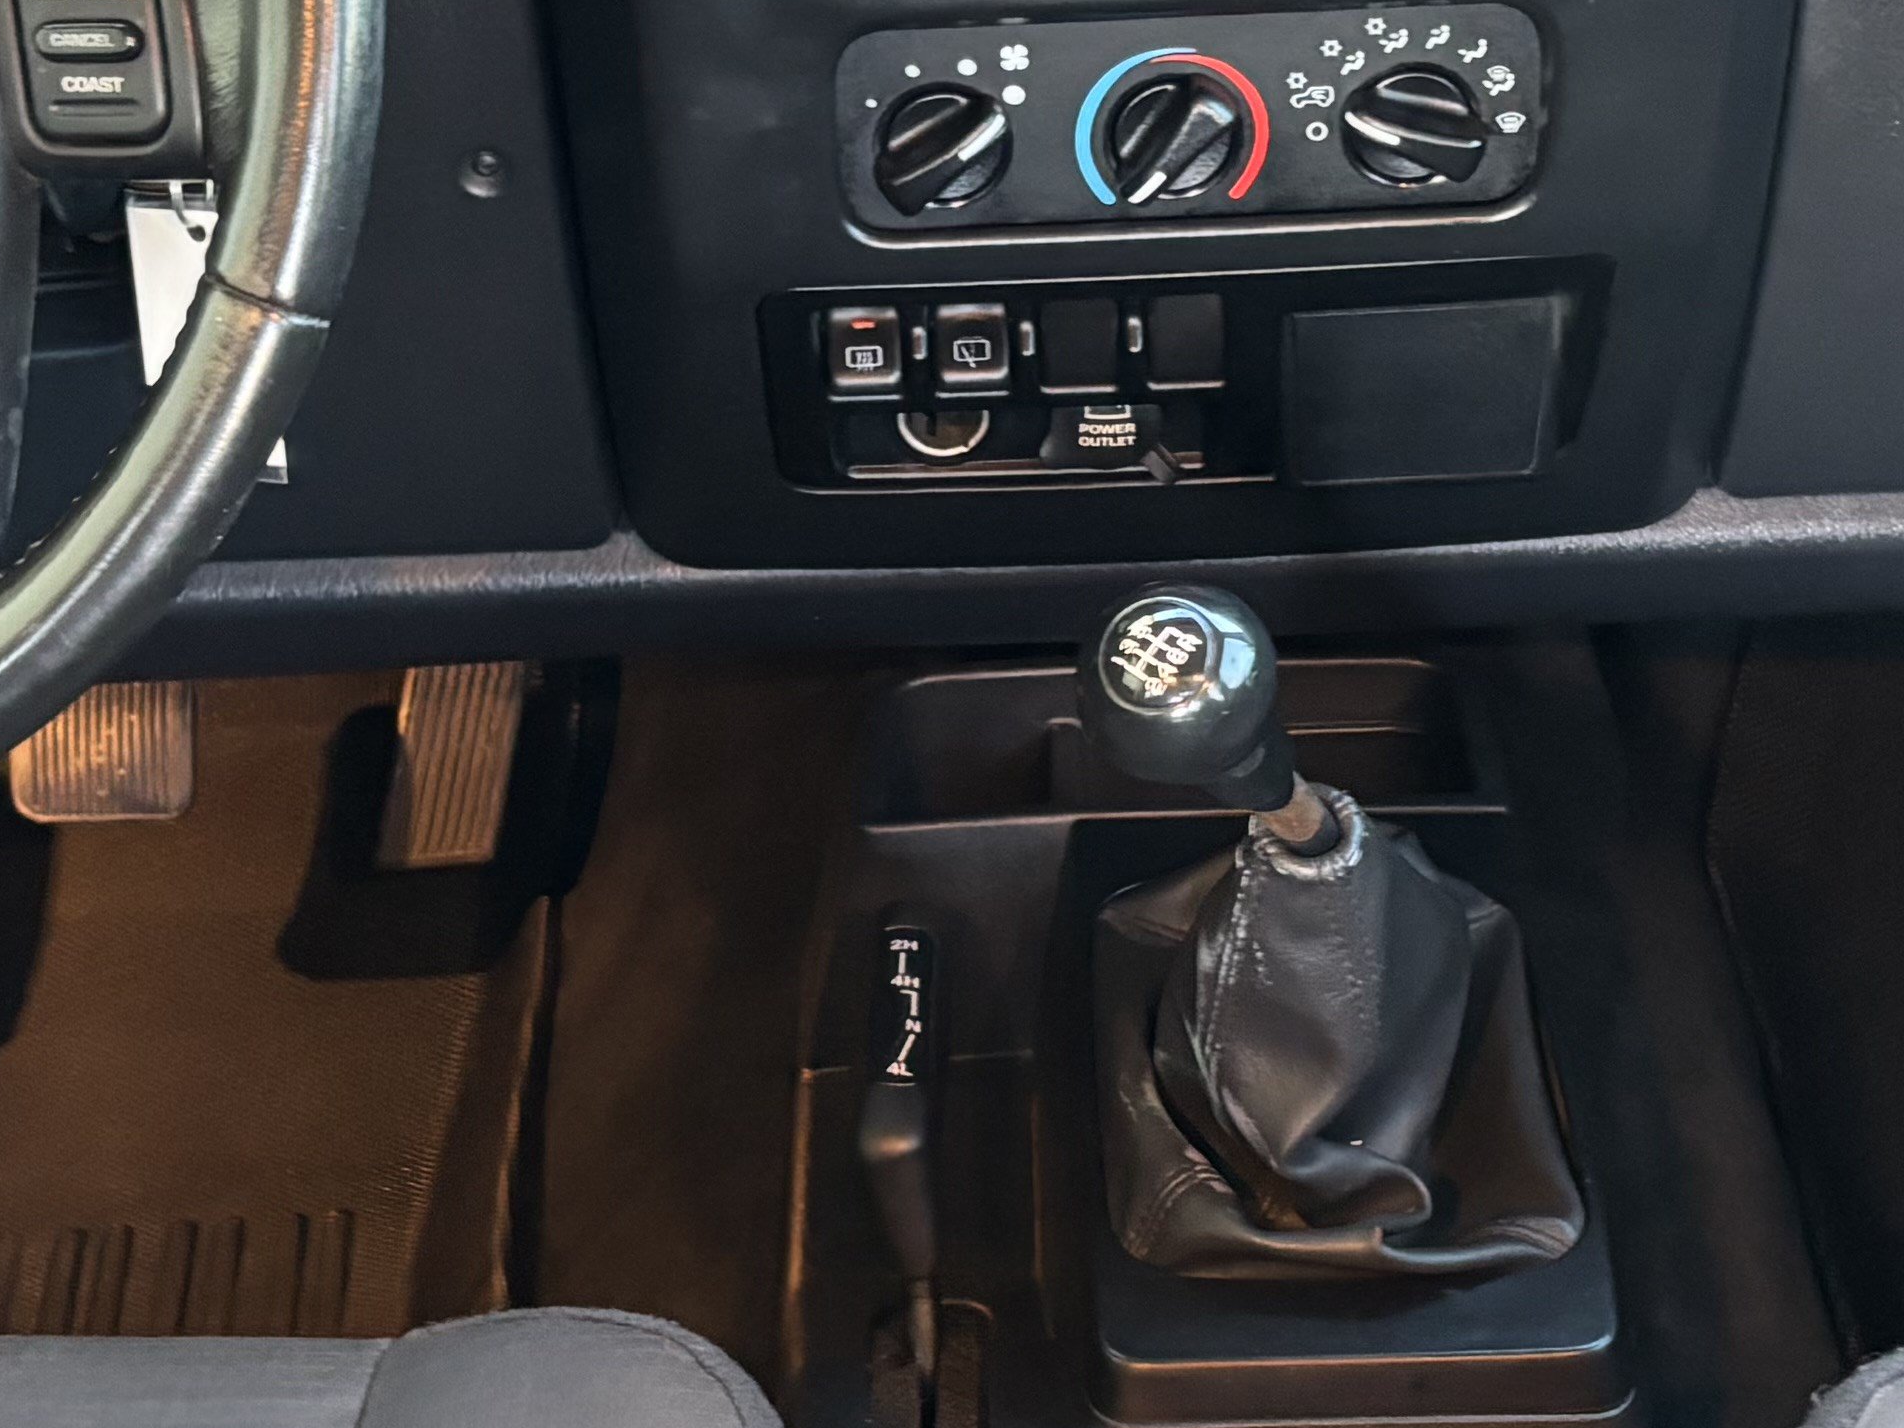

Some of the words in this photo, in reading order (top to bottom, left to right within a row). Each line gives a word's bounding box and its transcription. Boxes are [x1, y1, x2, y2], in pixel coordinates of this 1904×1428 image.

[60, 75, 126, 93] COAST
[1077, 422, 1138, 435] POWER
[1077, 435, 1138, 448] OUTLET
[904, 1017, 923, 1034] N
